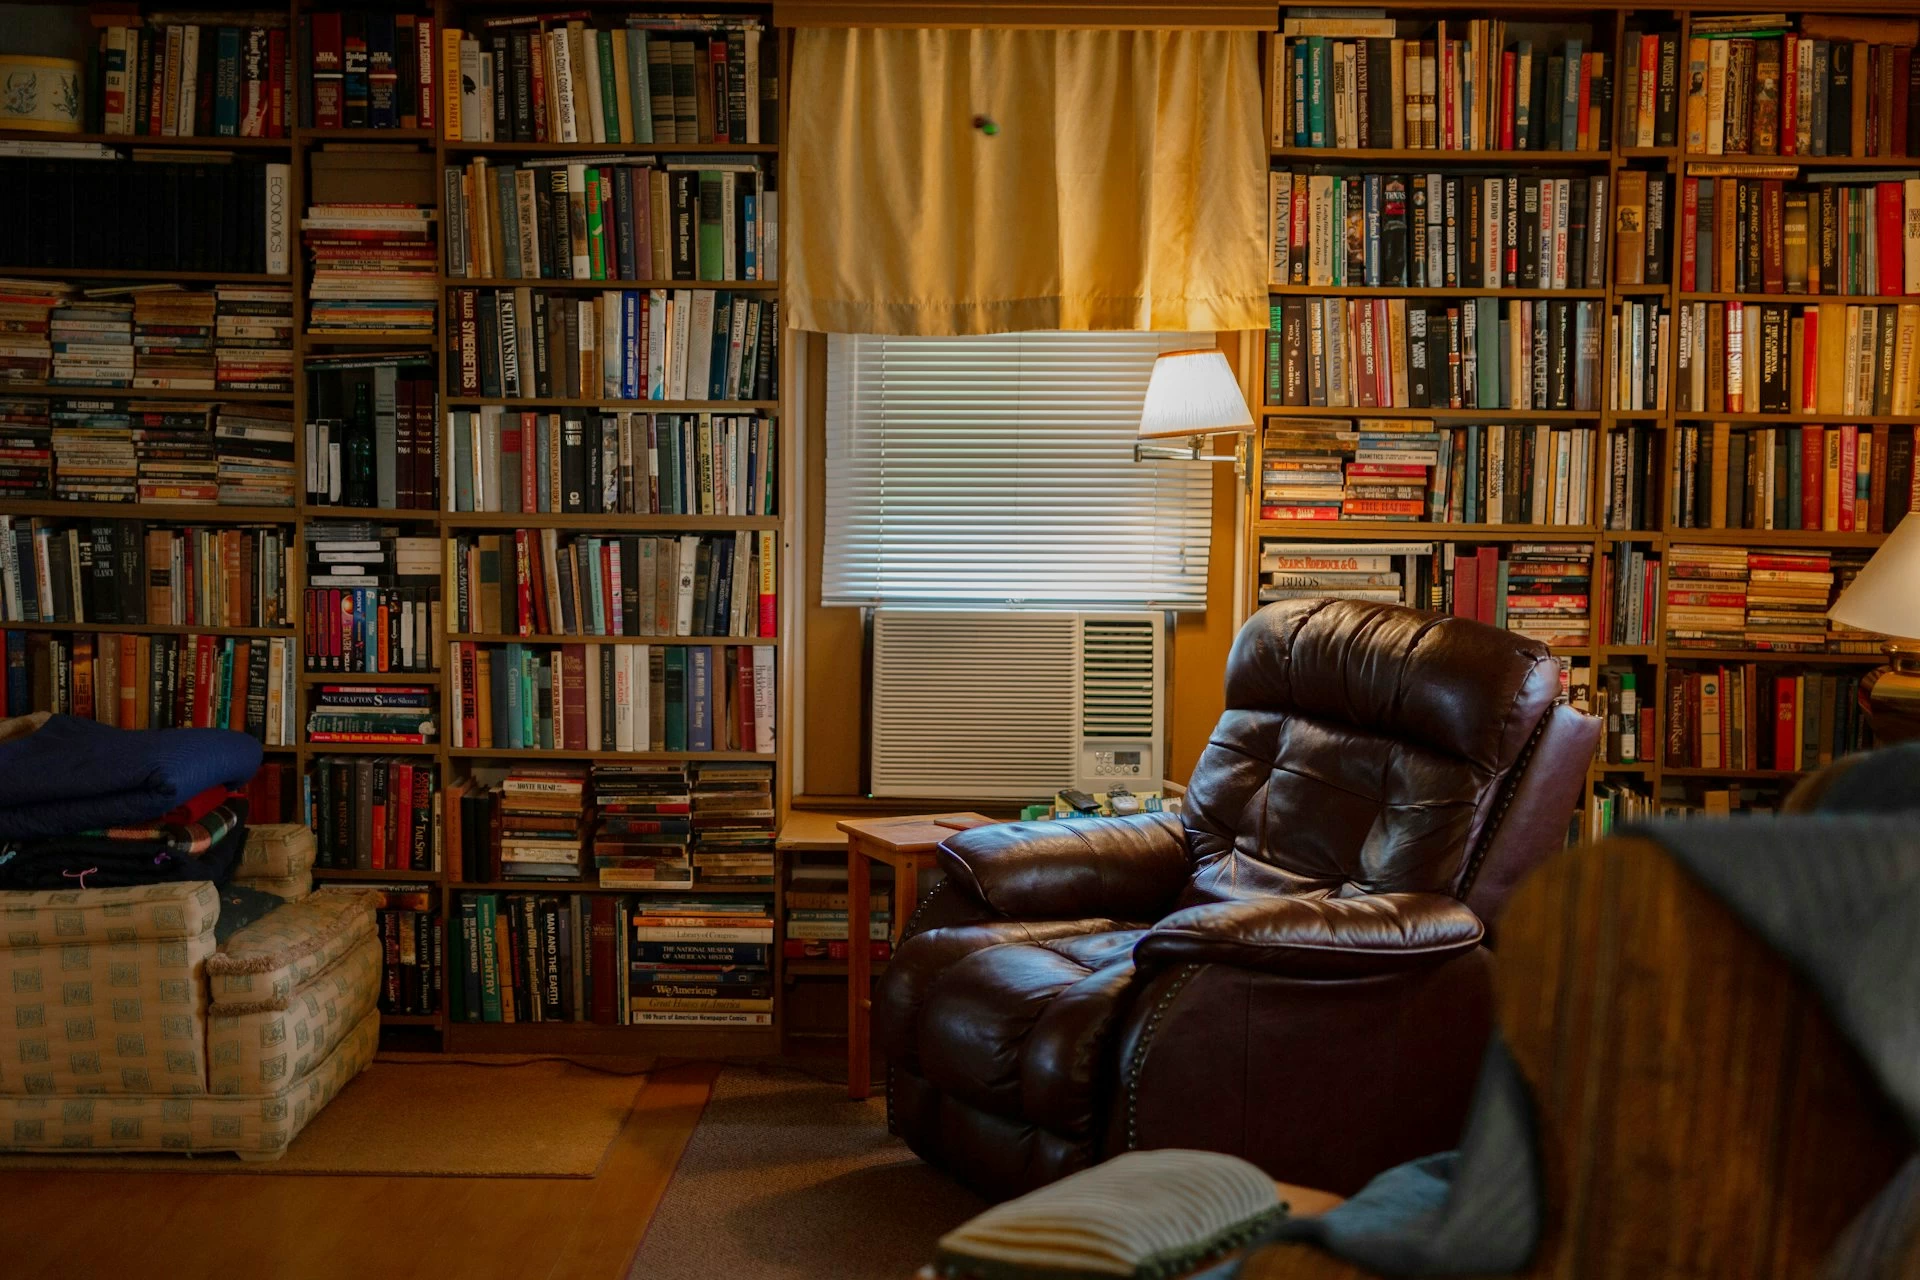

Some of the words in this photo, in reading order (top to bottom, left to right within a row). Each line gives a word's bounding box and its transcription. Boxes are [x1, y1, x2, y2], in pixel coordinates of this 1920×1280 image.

[553, 33, 565, 57] HAROLD
[1357, 40, 1366, 62] PETER
[1663, 42, 1674, 55] SKY
[555, 58, 566, 77] COYLE
[1295, 59, 1304, 101] MAIL-ORDER
[1357, 64, 1367, 90] LYNCH
[1662, 56, 1674, 86] MASTERS
[448, 69, 457, 94] ROBERT
[557, 78, 568, 93] CODE
[1312, 79, 1321, 105] Design
[449, 103, 458, 128] PARKER
[560, 103, 570, 124] HONOR
[1296, 103, 1304, 134] BUSINESS
[552, 170, 568, 192] ICON
[1490, 181, 1499, 201] LARRY
[1508, 178, 1517, 209] STUART
[1541, 183, 1551, 203] W.E.B.
[1558, 183, 1568, 202] W.E.B.
[1275, 189, 1290, 217] MEN
[1823, 187, 1832, 203] The
[270, 175, 283, 254] ECONOMICS
[319, 208, 335, 217] THE
[339, 208, 383, 217] AMERICAN
[386, 208, 420, 218] INDIAN
[556, 195, 567, 234] FREDERICK
[1490, 202, 1499, 220] BOND
[1541, 203, 1551, 230] GRIFFIN
[1558, 202, 1567, 229] GRIFFIN
[1750, 204, 1759, 232] PANIC
[1415, 208, 1425, 263] DETECTIVE
[1508, 210, 1517, 246] WOODS
[1593, 209, 1602, 242] THOUSAND
[558, 237, 568, 268] FORSYTH
[1274, 237, 1289, 268] MEN
[1541, 235, 1550, 250] LINE
[1556, 233, 1566, 252] CLOSE
[1822, 227, 1832, 268] Alternative
[1490, 247, 1498, 272] WITHIN
[1541, 259, 1549, 278] FIRE
[1556, 253, 1565, 280] COMBAT
[463, 292, 473, 318] FULLER
[1312, 303, 1321, 328] HONOR
[1331, 300, 1339, 315] FOR
[1364, 303, 1372, 317] THE
[1331, 317, 1341, 337] KING
[1417, 310, 1426, 337] RED
[1680, 312, 1688, 326] GOD
[1764, 324, 1771, 334] OF
[1885, 312, 1893, 326] THE
[1312, 329, 1322, 355] BOUND
[1364, 318, 1373, 355] LONESOME
[1680, 328, 1688, 337] OF
[1885, 327, 1893, 345] NEW
[461, 321, 477, 389] SYNERGETICS
[1365, 356, 1373, 375] GODS
[1417, 342, 1426, 369] LARRY
[1533, 328, 1548, 395] SPYCATCHER
[1680, 338, 1688, 368] BATTLES
[1770, 339, 1778, 374] CARDINAL
[1884, 346, 1892, 371] BREED
[505, 357, 516, 381] STING
[1332, 355, 1342, 392] COUNTRY
[1763, 350, 1771, 383] KREMLIN
[1489, 454, 1498, 499] AGGRESSION
[1615, 477, 1623, 520] FLOODGATE
[763, 537, 771, 560] ROBERT
[457, 564, 469, 612] SEAWITCH
[1281, 576, 1319, 587] BIRDS
[342, 625, 352, 651] REVUE
[694, 652, 705, 665] DEBT
[58, 662, 67, 687] How
[463, 658, 475, 696] DESERT
[694, 674, 705, 697] HONOR
[754, 665, 766, 702] Huckleberry
[184, 674, 195, 722] COLLAPSE
[324, 695, 338, 704] SUE
[338, 696, 372, 704] GRAFTON
[374, 694, 383, 706] S
[397, 697, 418, 705] Silence
[508, 668, 519, 707] German
[1670, 684, 1683, 699] The
[463, 698, 475, 719] FIRE
[1670, 729, 1683, 755] Rachel
[413, 772, 421, 808] COULTER
[421, 772, 429, 808] CATHERINE
[517, 783, 536, 791] MONTE
[536, 783, 556, 791] WALSH
[524, 902, 535, 912] Up
[524, 913, 534, 928] your
[546, 913, 556, 934] MAN
[664, 918, 706, 927] NASA
[421, 929, 430, 960] GRAFTON
[527, 928, 538, 948] OWN
[548, 935, 557, 955] AND
[584, 926, 592, 948] Cosmic
[676, 931, 700, 941] Library
[709, 931, 739, 941] Congress
[483, 927, 496, 995] CARPENTRY
[662, 953, 671, 961] OF
[707, 946, 735, 954] MUSEUM
[549, 956, 557, 973] THE
[549, 974, 559, 1004] EARTH
[652, 985, 672, 997] We
[671, 986, 718, 996] Americans
[675, 1014, 698, 1022] American
[700, 1015, 727, 1023] Newspaper
